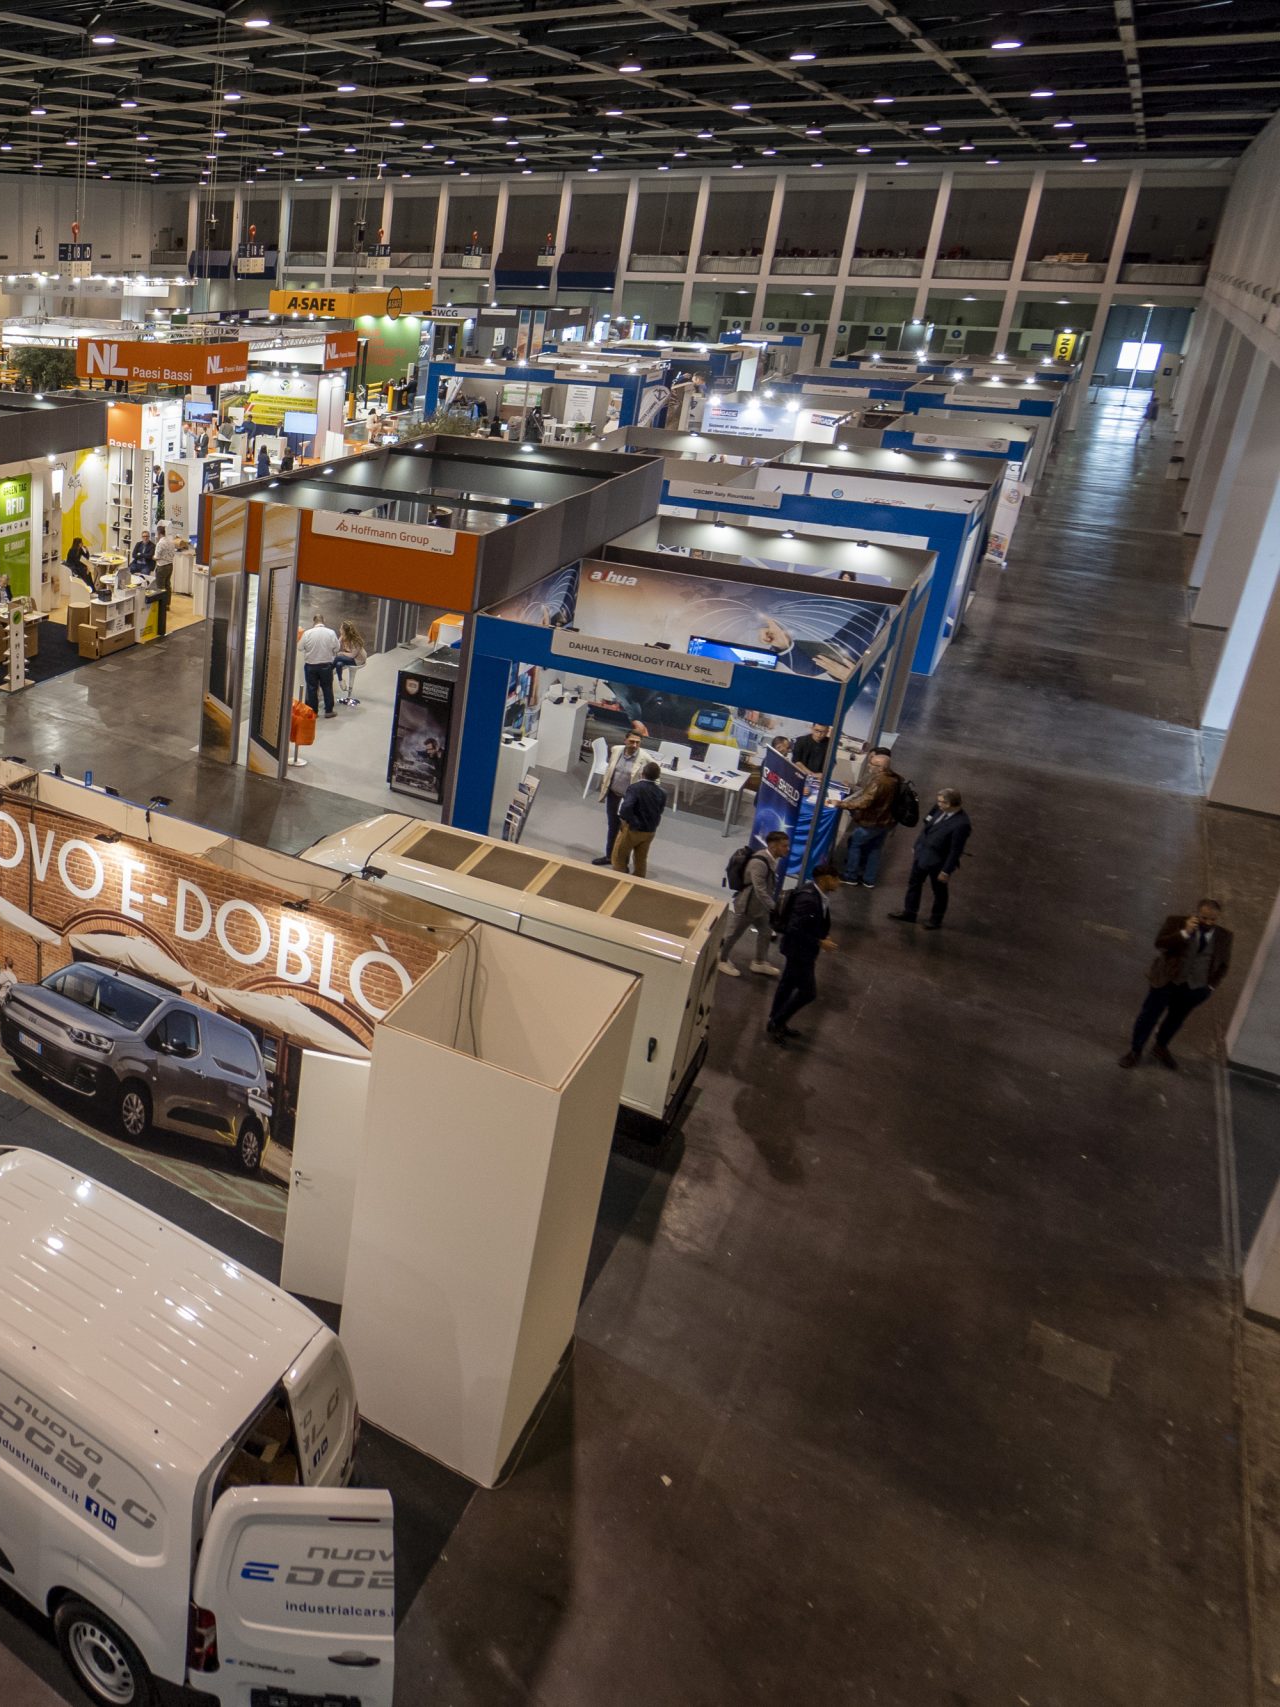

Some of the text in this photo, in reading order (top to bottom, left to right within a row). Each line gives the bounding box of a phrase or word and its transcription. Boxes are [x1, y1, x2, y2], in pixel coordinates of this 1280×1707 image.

[437, 309, 458, 317] WCG
[86, 342, 192, 381] NL Paesi Bassi
[207, 355, 224, 374] NL
[5, 496, 25, 516] RFID
[350, 524, 430, 547] Hoffmann Group
[568, 641, 713, 676] DAHUA TECHNOLOGY ITALY SRL
[120, 855, 413, 1020] E-DOBLÒ
[14, 1395, 103, 1466] nuovo
[240, 1561, 279, 1582] E
